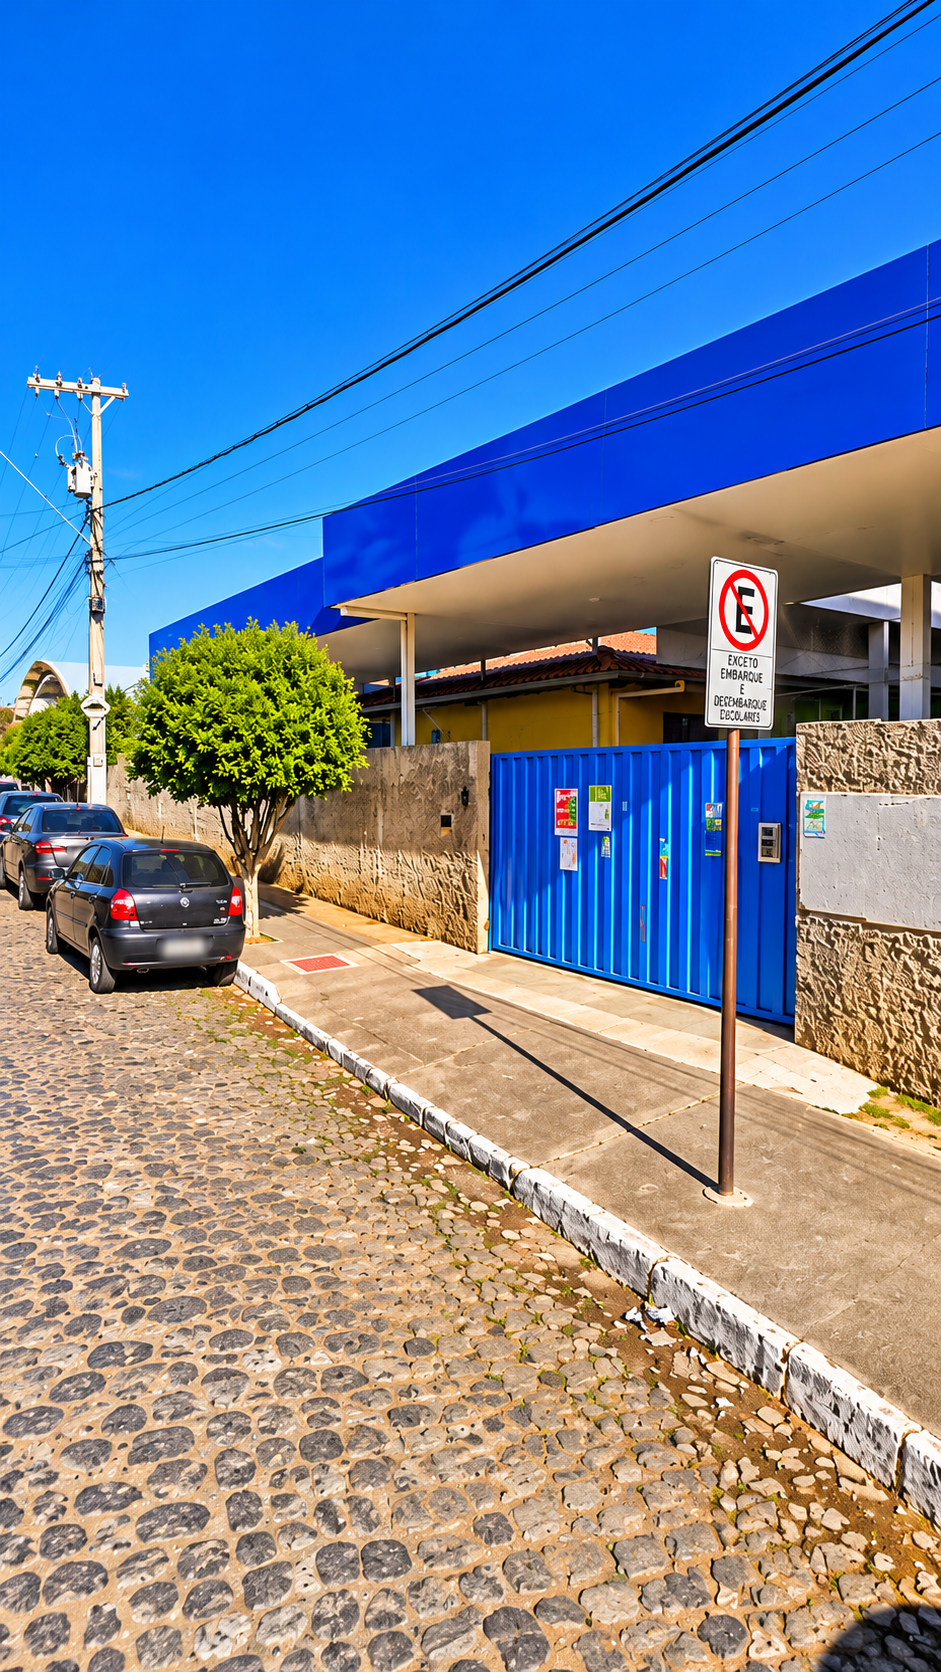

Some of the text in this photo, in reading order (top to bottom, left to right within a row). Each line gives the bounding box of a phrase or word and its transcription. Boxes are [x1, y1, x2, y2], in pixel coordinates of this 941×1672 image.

[735, 586, 755, 635] E
[728, 654, 758, 669] EXCETO
[720, 668, 763, 684] EMBARQUE
[740, 684, 745, 695] E
